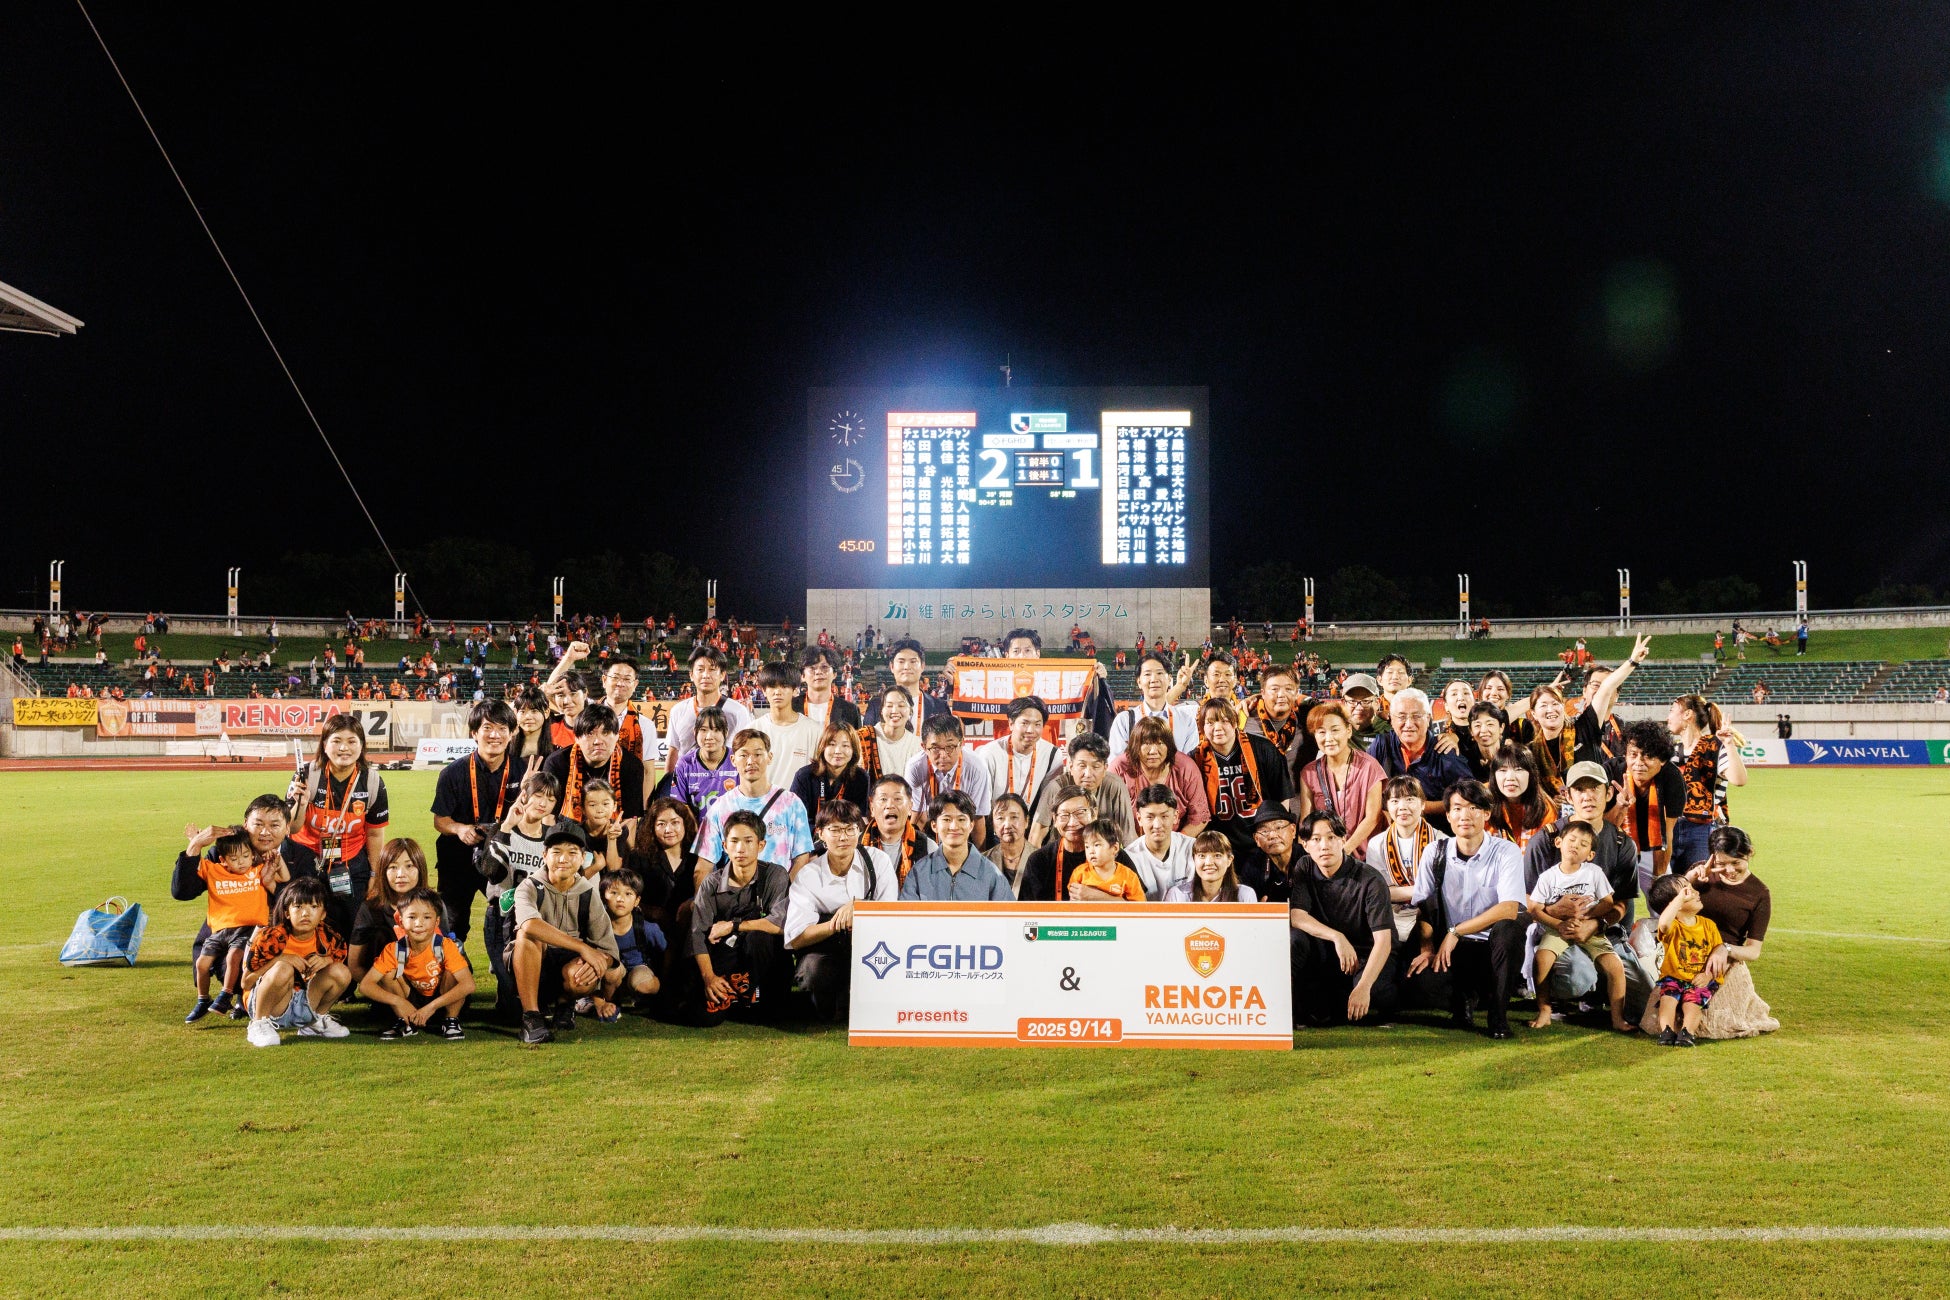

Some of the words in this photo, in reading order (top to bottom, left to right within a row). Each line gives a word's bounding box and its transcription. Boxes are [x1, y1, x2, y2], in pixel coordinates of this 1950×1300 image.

[979, 449, 1009, 487] 2
[1018, 457, 1026, 467] 1
[1029, 457, 1049, 467] 前半
[1051, 457, 1059, 467] 0
[1071, 449, 1099, 487] 1
[831, 465, 842, 473] 45
[1018, 470, 1026, 480] 1
[1029, 470, 1049, 480] 後半
[1052, 470, 1059, 480] 1
[919, 604, 1129, 619] 維新みらいふスタジアム
[131, 702, 145, 712] FOR
[148, 702, 161, 712] THE
[163, 702, 190, 712] FUTURE
[971, 703, 1000, 713] HIKARU
[1048, 703, 1077, 714] ARUOKA
[132, 713, 141, 722] OF
[143, 713, 156, 722] THE
[132, 724, 177, 734] YAMAGUCHI
[1832, 746, 1910, 758] VAN-VEAL
[906, 945, 1003, 970] FGHD
[906, 971, 1004, 980] 富士商グループホールディングス
[1060, 967, 1080, 991] &
[1145, 985, 1266, 1009] RENOFA
[897, 1010, 968, 1024] presents
[1146, 1012, 1242, 1026] YAMAGUCHI
[1247, 1013, 1266, 1026] FC
[1027, 1023, 1066, 1036] 2025
[1069, 1020, 1112, 1037] 9/14
